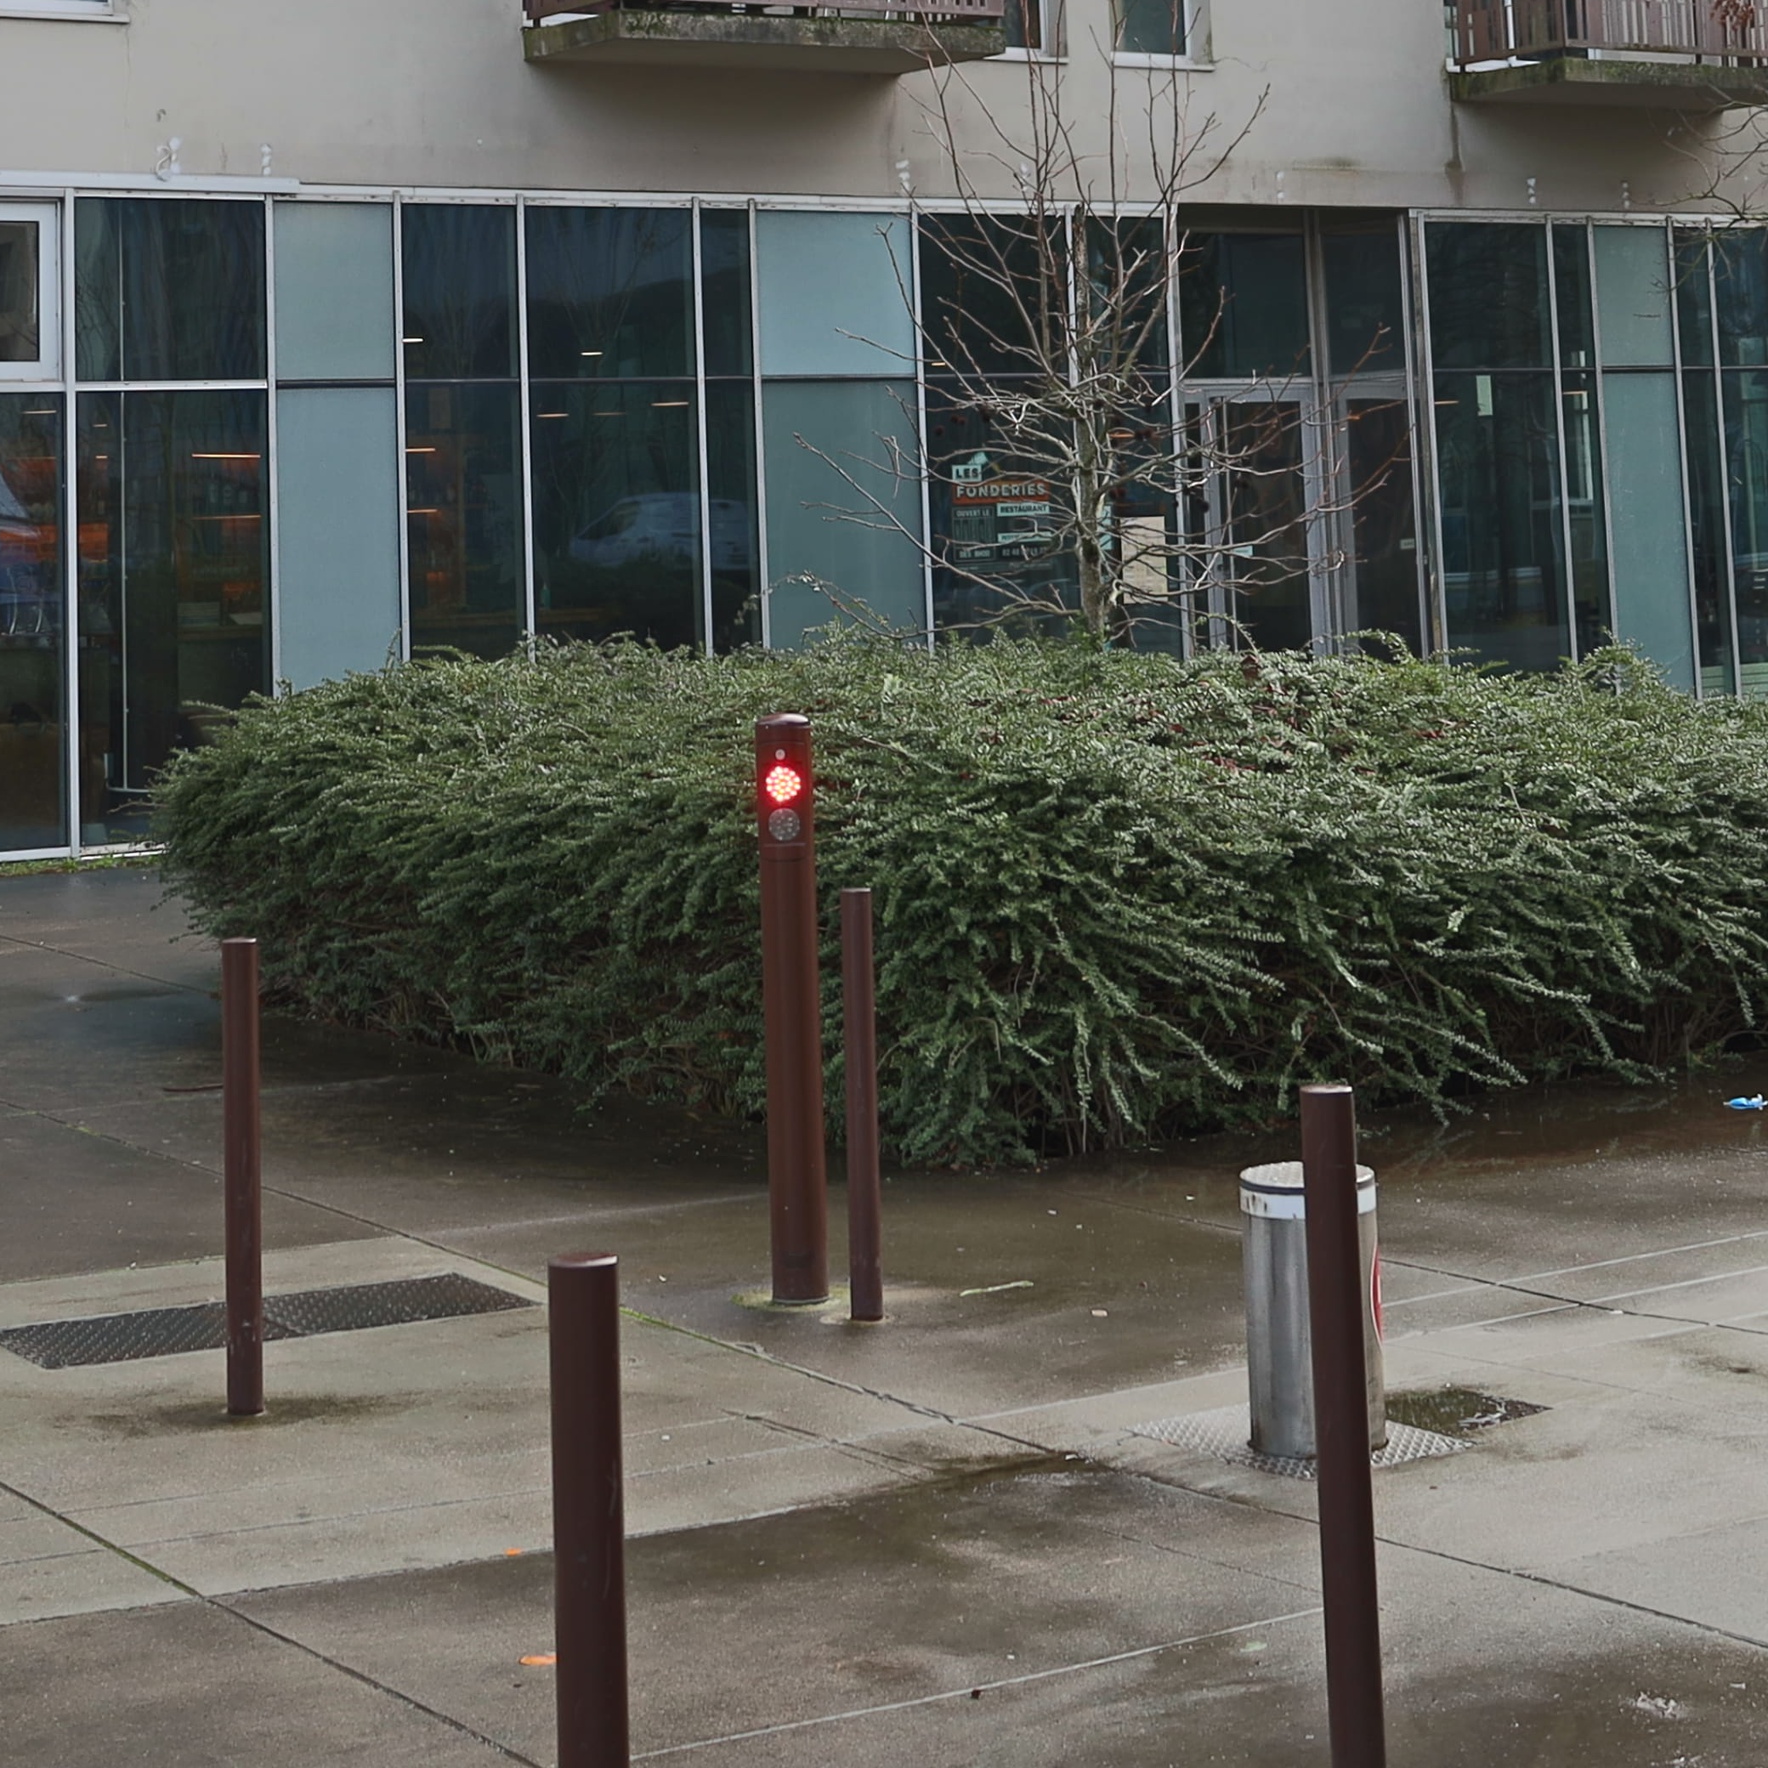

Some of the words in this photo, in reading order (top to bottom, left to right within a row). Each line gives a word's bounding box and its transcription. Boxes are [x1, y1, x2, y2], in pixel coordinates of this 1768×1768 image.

[955, 467, 979, 479] LES
[956, 483, 1046, 498] FONDERIES
[1000, 504, 1047, 513] RESTAURANT
